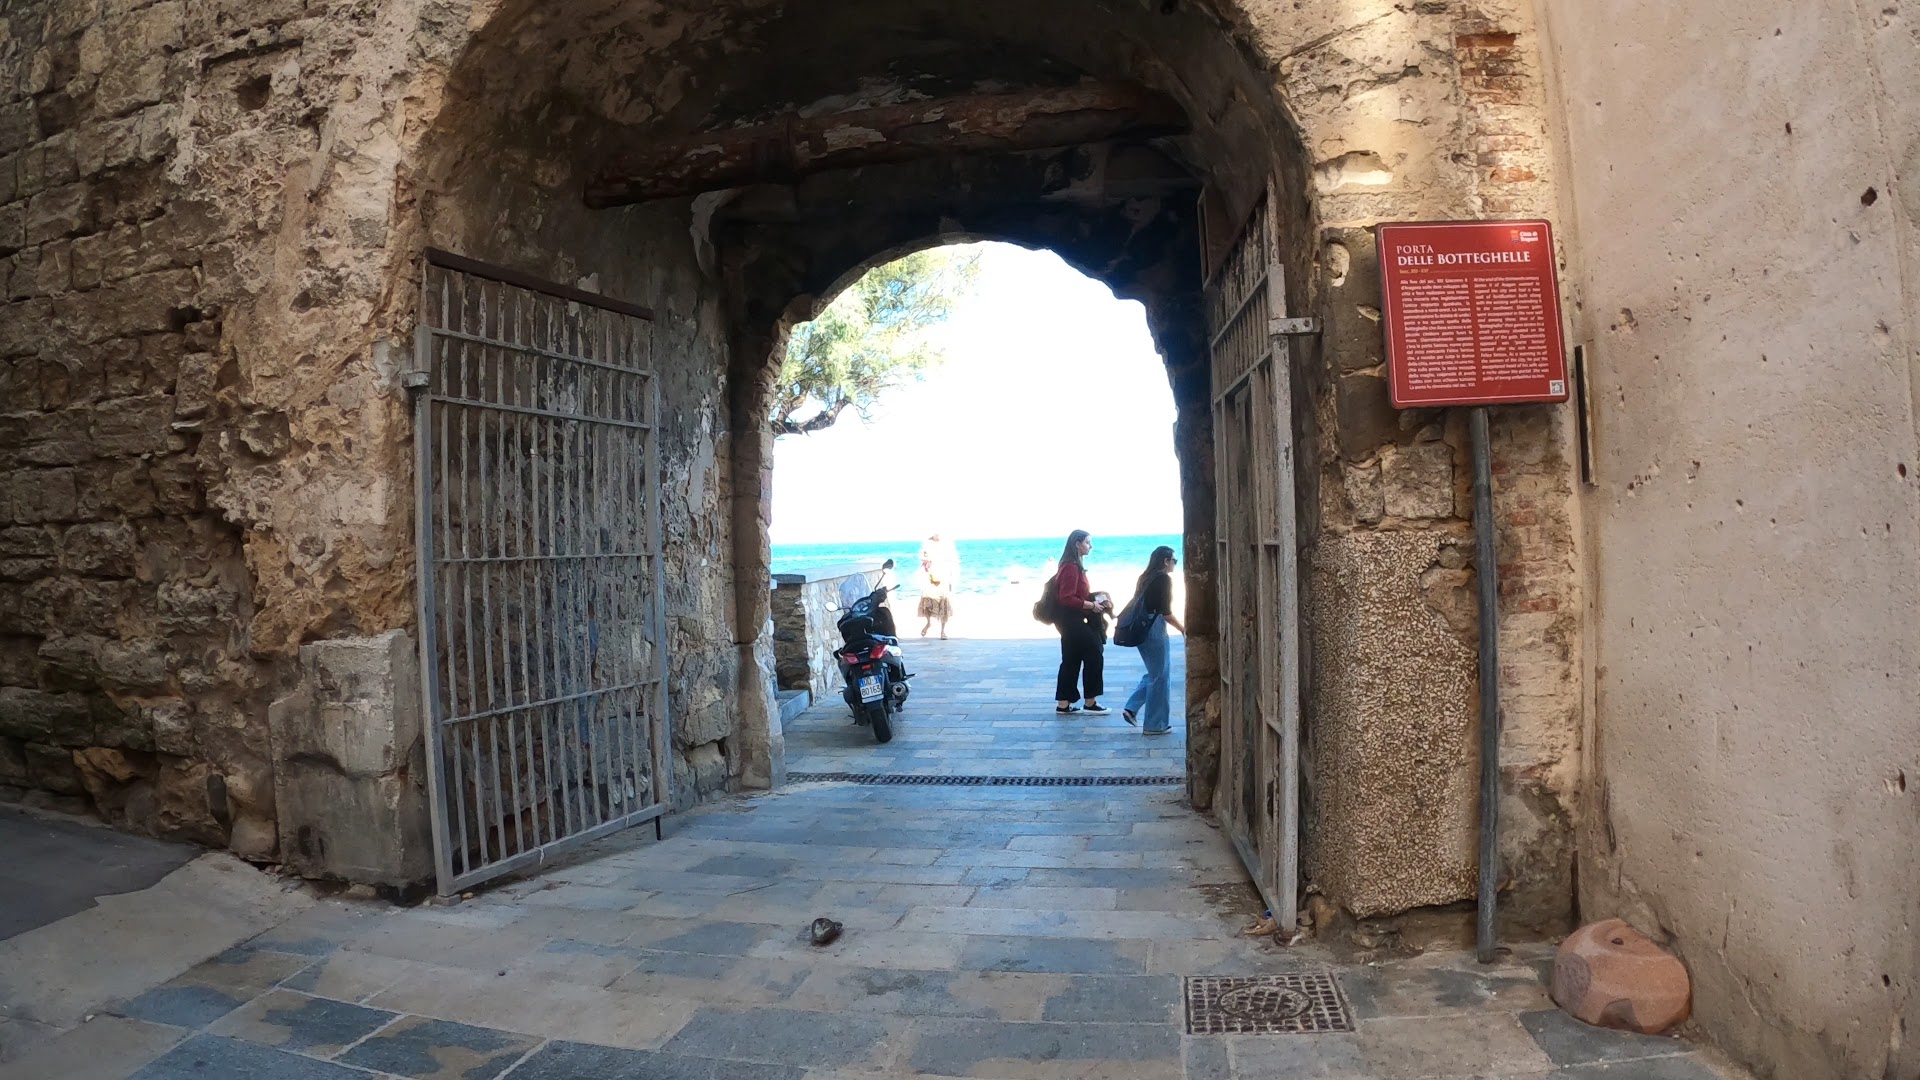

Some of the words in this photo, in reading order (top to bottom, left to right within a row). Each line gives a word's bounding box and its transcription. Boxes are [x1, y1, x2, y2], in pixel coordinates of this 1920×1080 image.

[1396, 245, 1434, 254] PORTA
[1398, 255, 1434, 266] DELLE
[1437, 251, 1531, 265] BOTTEGHELLE
